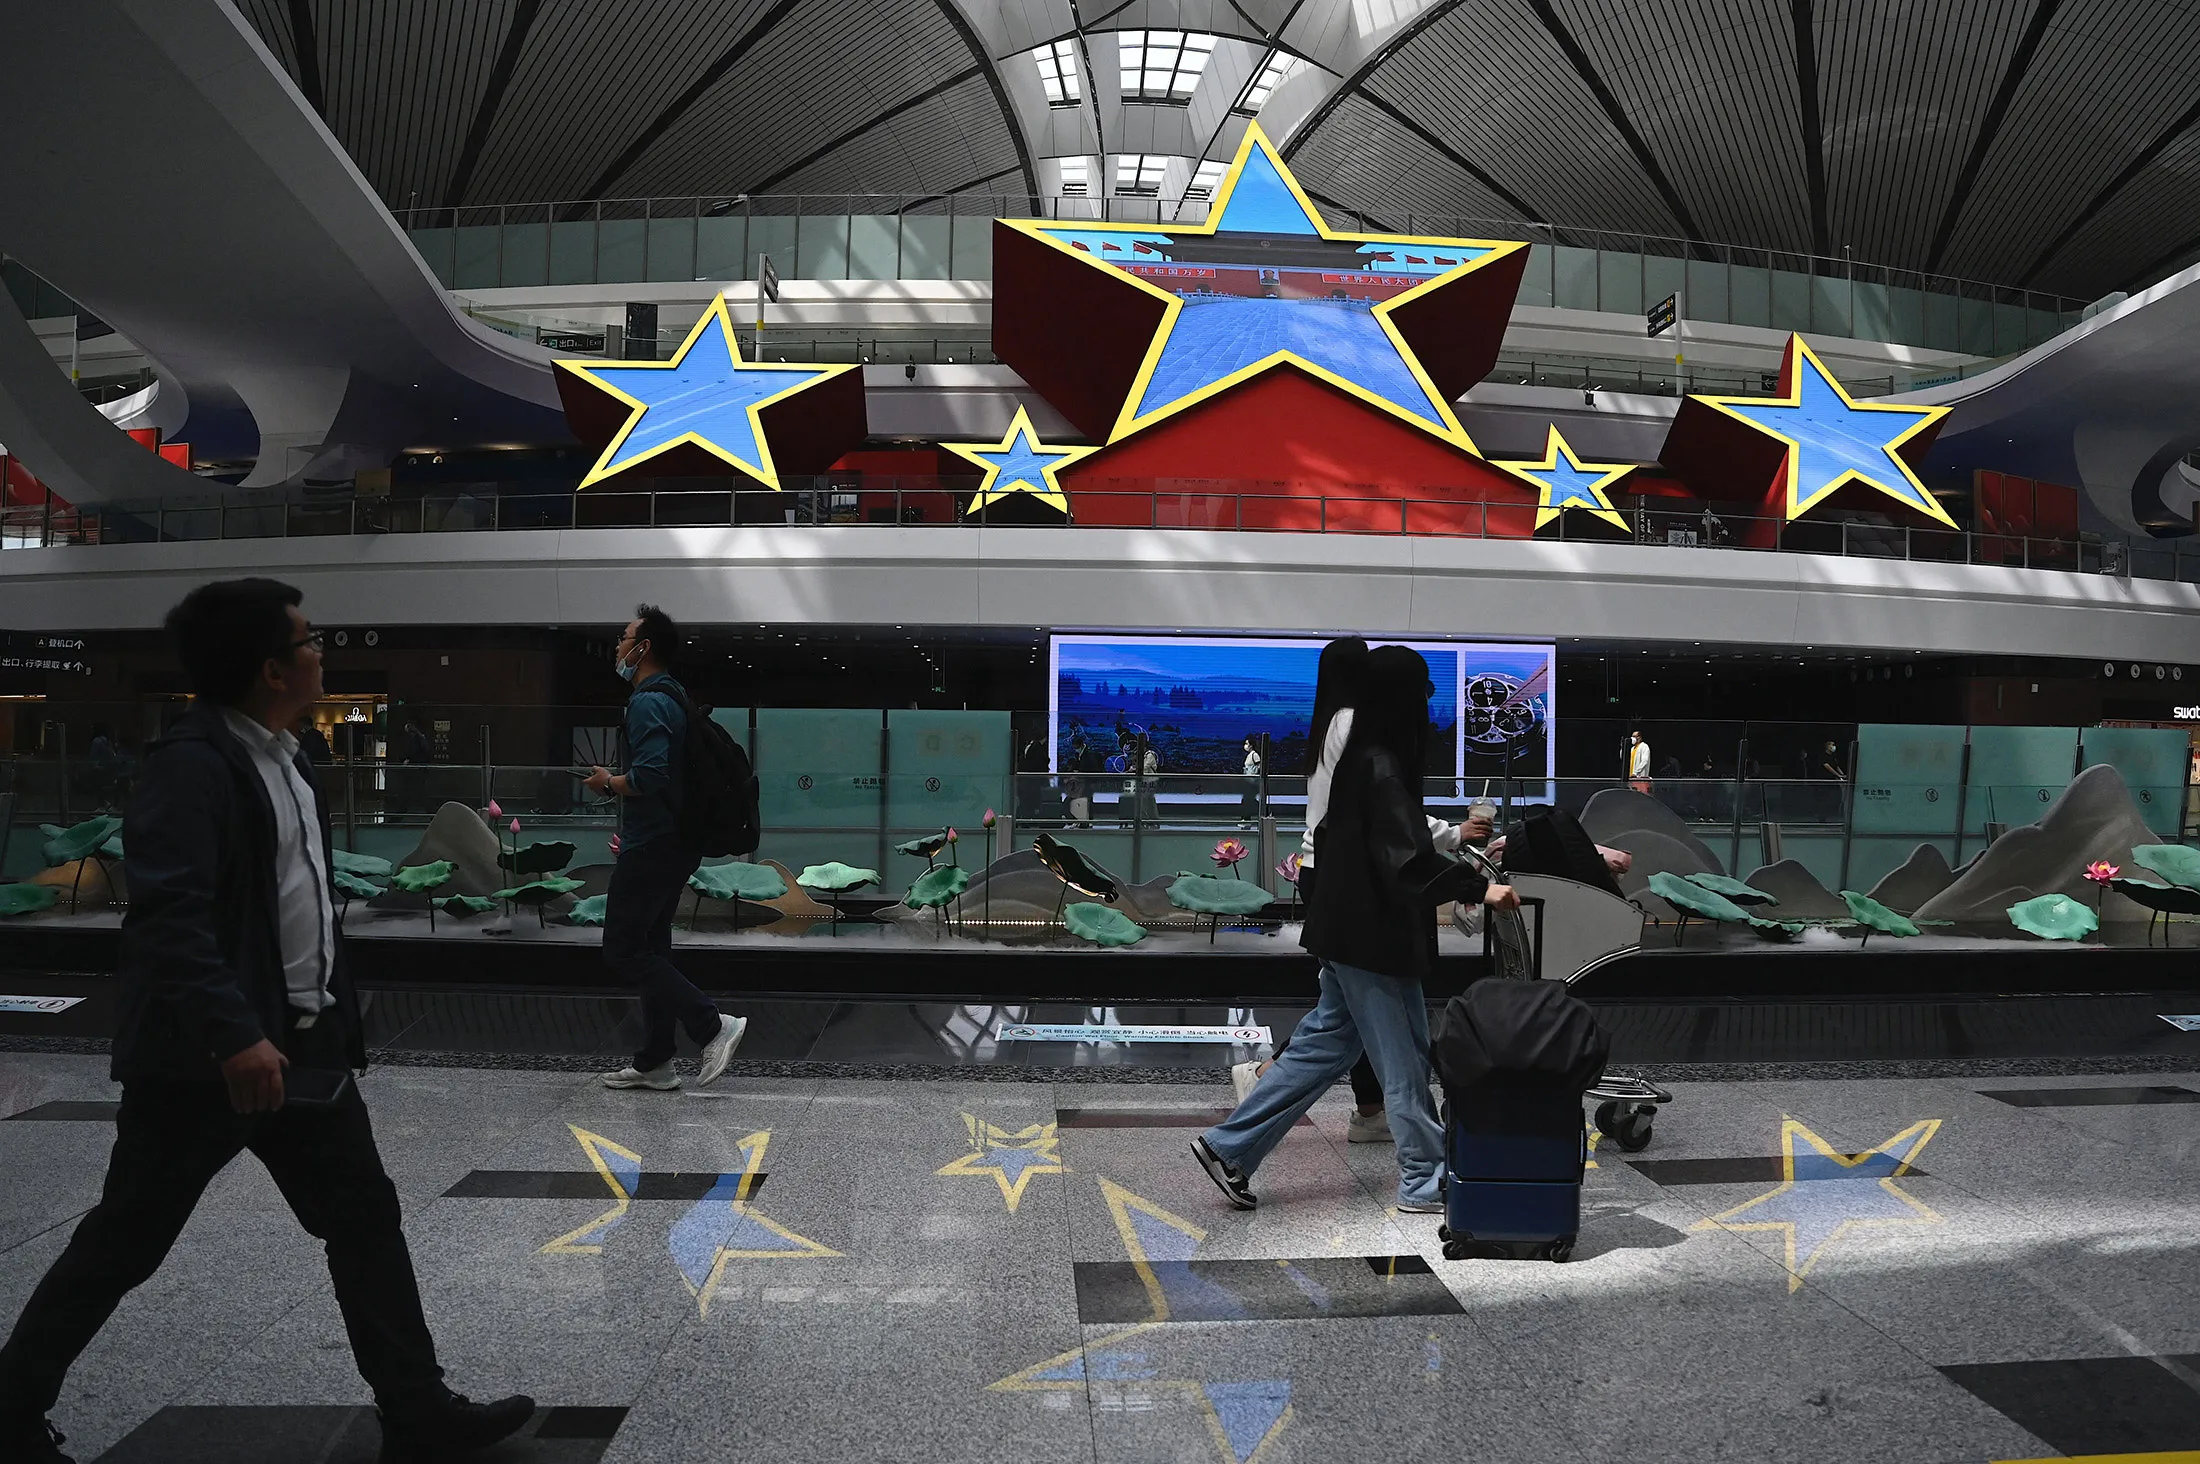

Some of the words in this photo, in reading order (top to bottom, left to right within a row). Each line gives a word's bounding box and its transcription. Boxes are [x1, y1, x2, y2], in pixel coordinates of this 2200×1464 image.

[1125, 266, 1206, 276] 民共和国万岁
[559, 339, 575, 348] 出口
[48, 638, 74, 648] 登机口
[1, 657, 60, 670] 出口、行李提取
